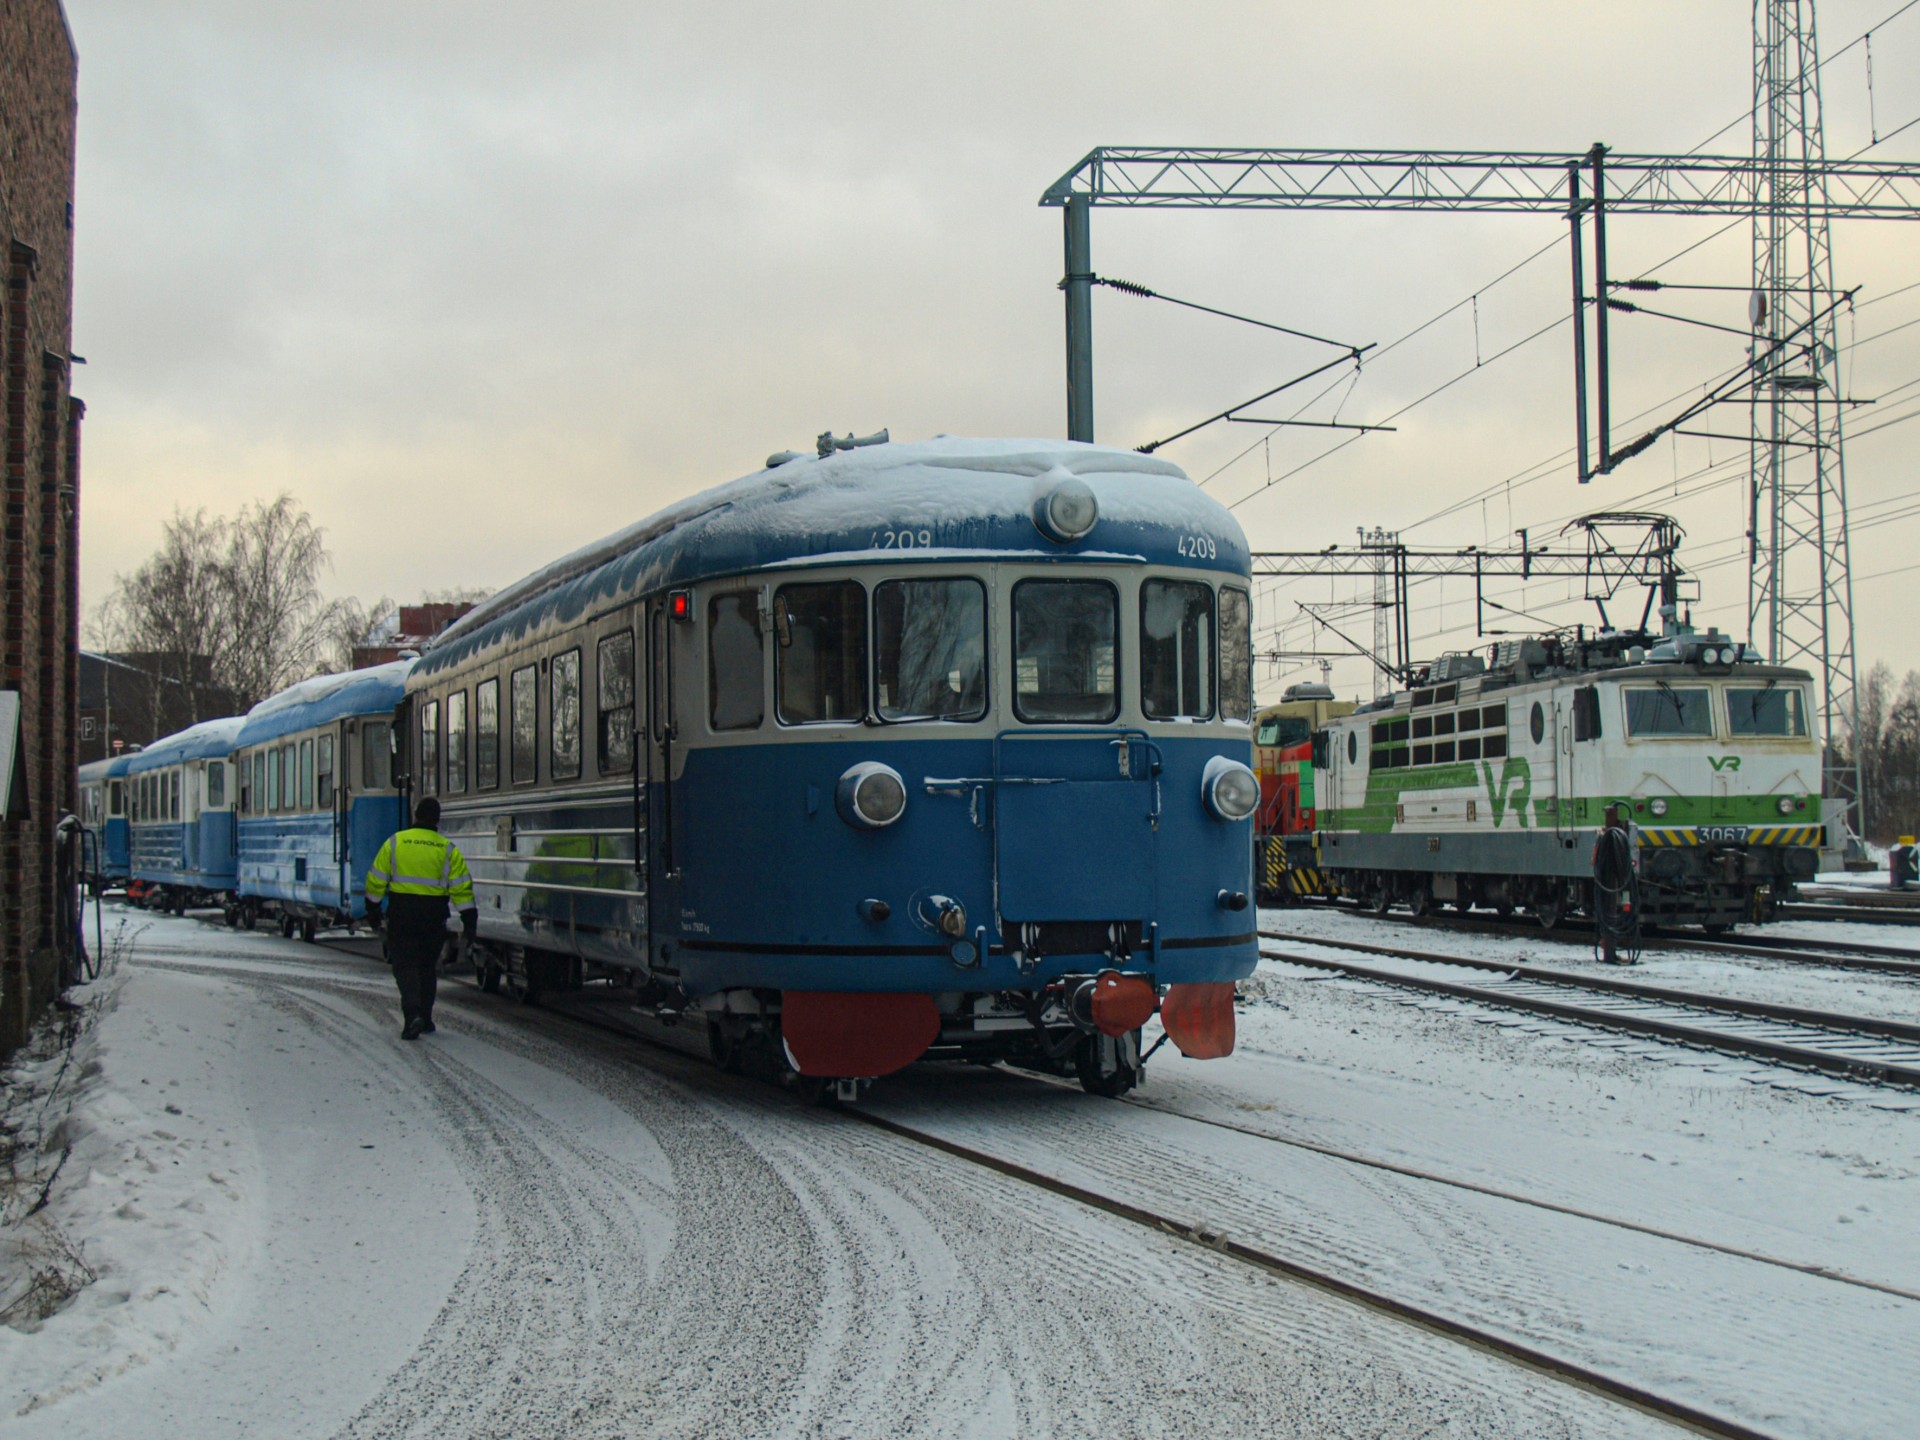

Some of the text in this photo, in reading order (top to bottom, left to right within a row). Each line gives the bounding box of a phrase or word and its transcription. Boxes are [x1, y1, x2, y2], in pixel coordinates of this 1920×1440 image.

[870, 529, 931, 549] 4209
[1177, 535, 1216, 560] 4209
[1707, 755, 1741, 771] VR
[1481, 757, 1531, 828] VR
[1699, 827, 1747, 844] 3067
